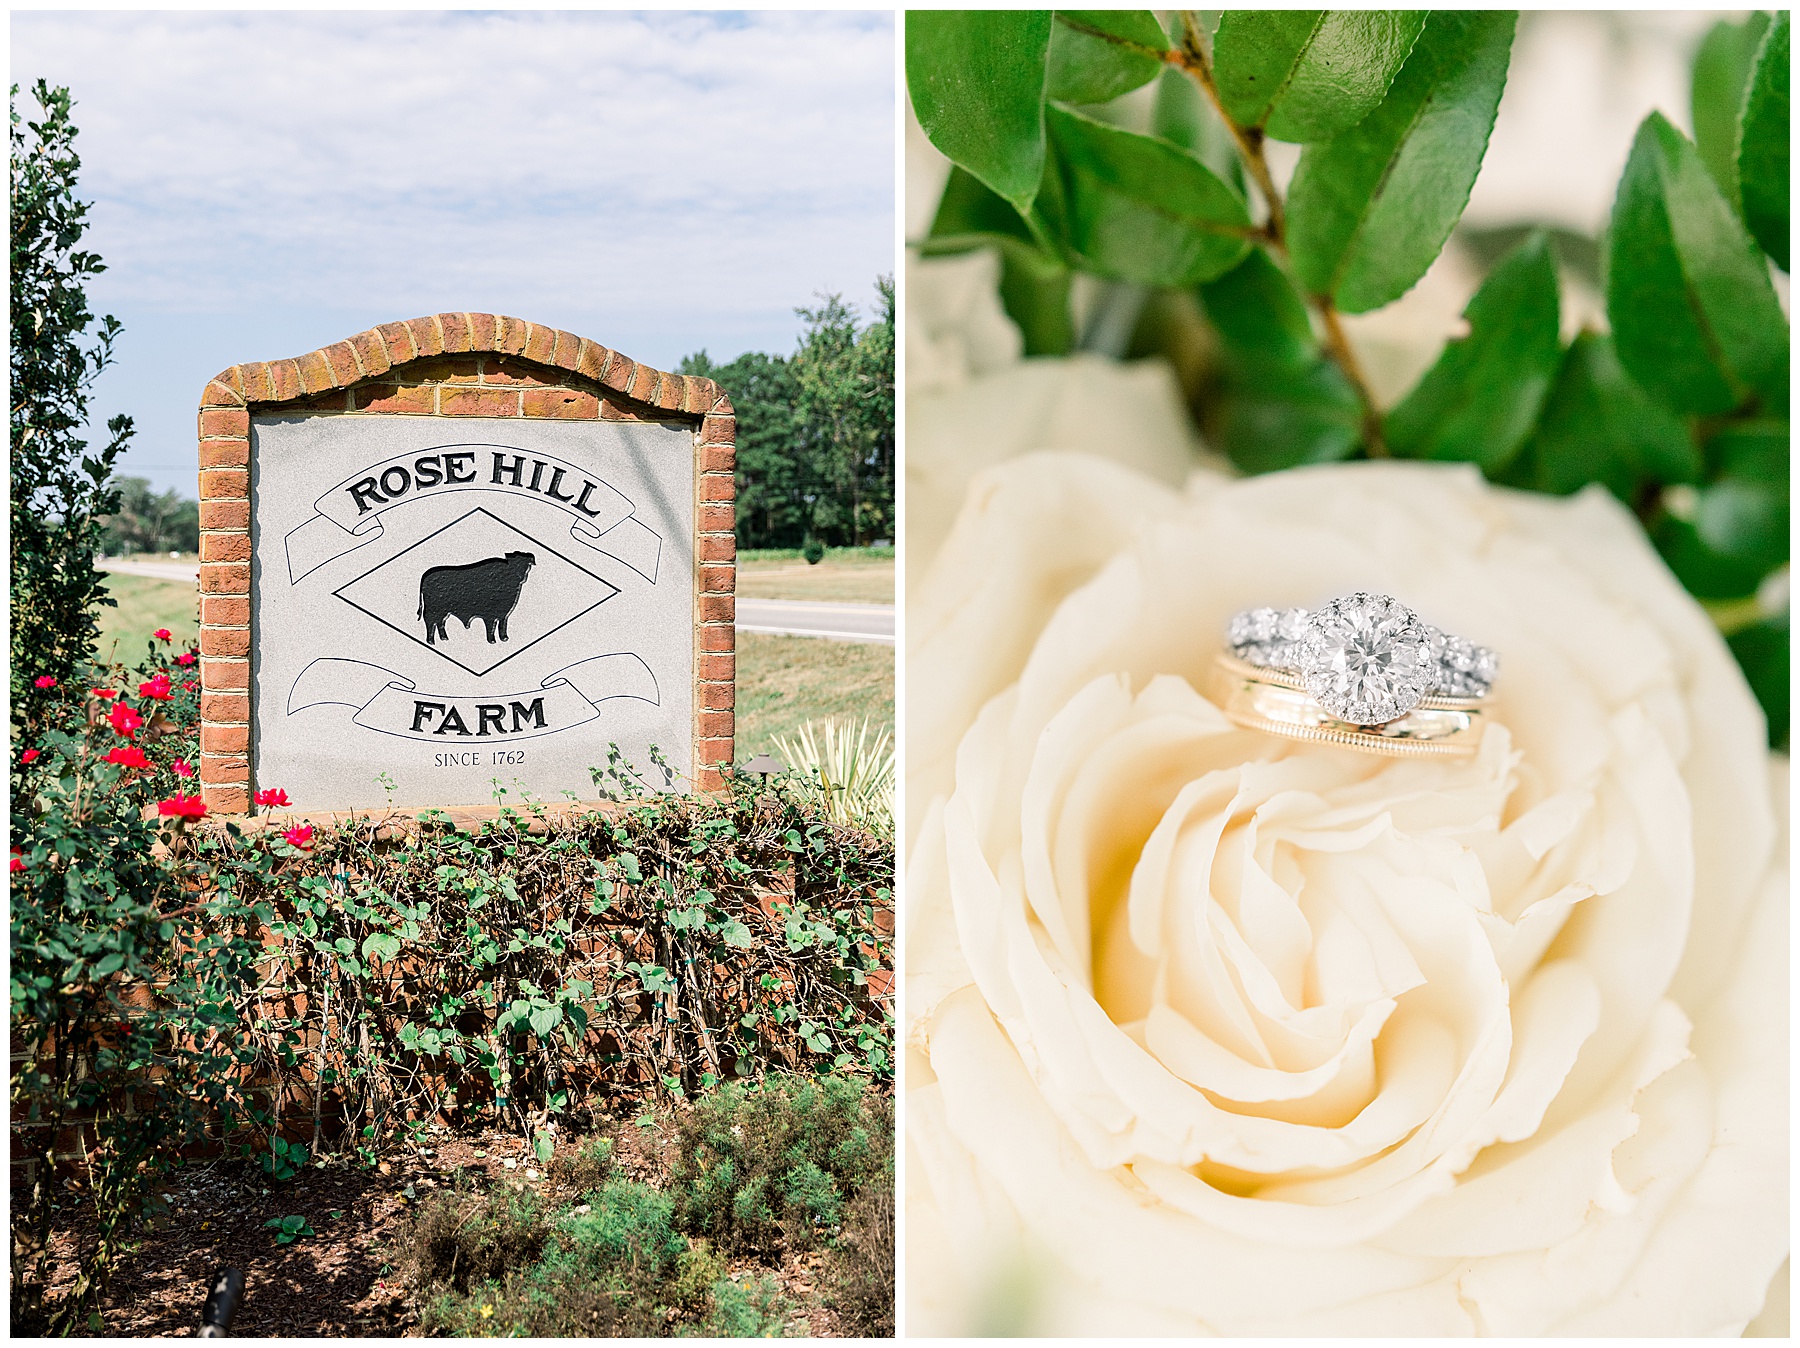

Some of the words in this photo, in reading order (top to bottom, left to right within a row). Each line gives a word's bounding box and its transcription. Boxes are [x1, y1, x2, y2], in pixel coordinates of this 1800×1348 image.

[346, 452, 476, 516] ROSE
[490, 452, 601, 517] HILL
[409, 697, 547, 735] FARM
[434, 752, 481, 767] SINCE
[492, 750, 525, 766] 1762
